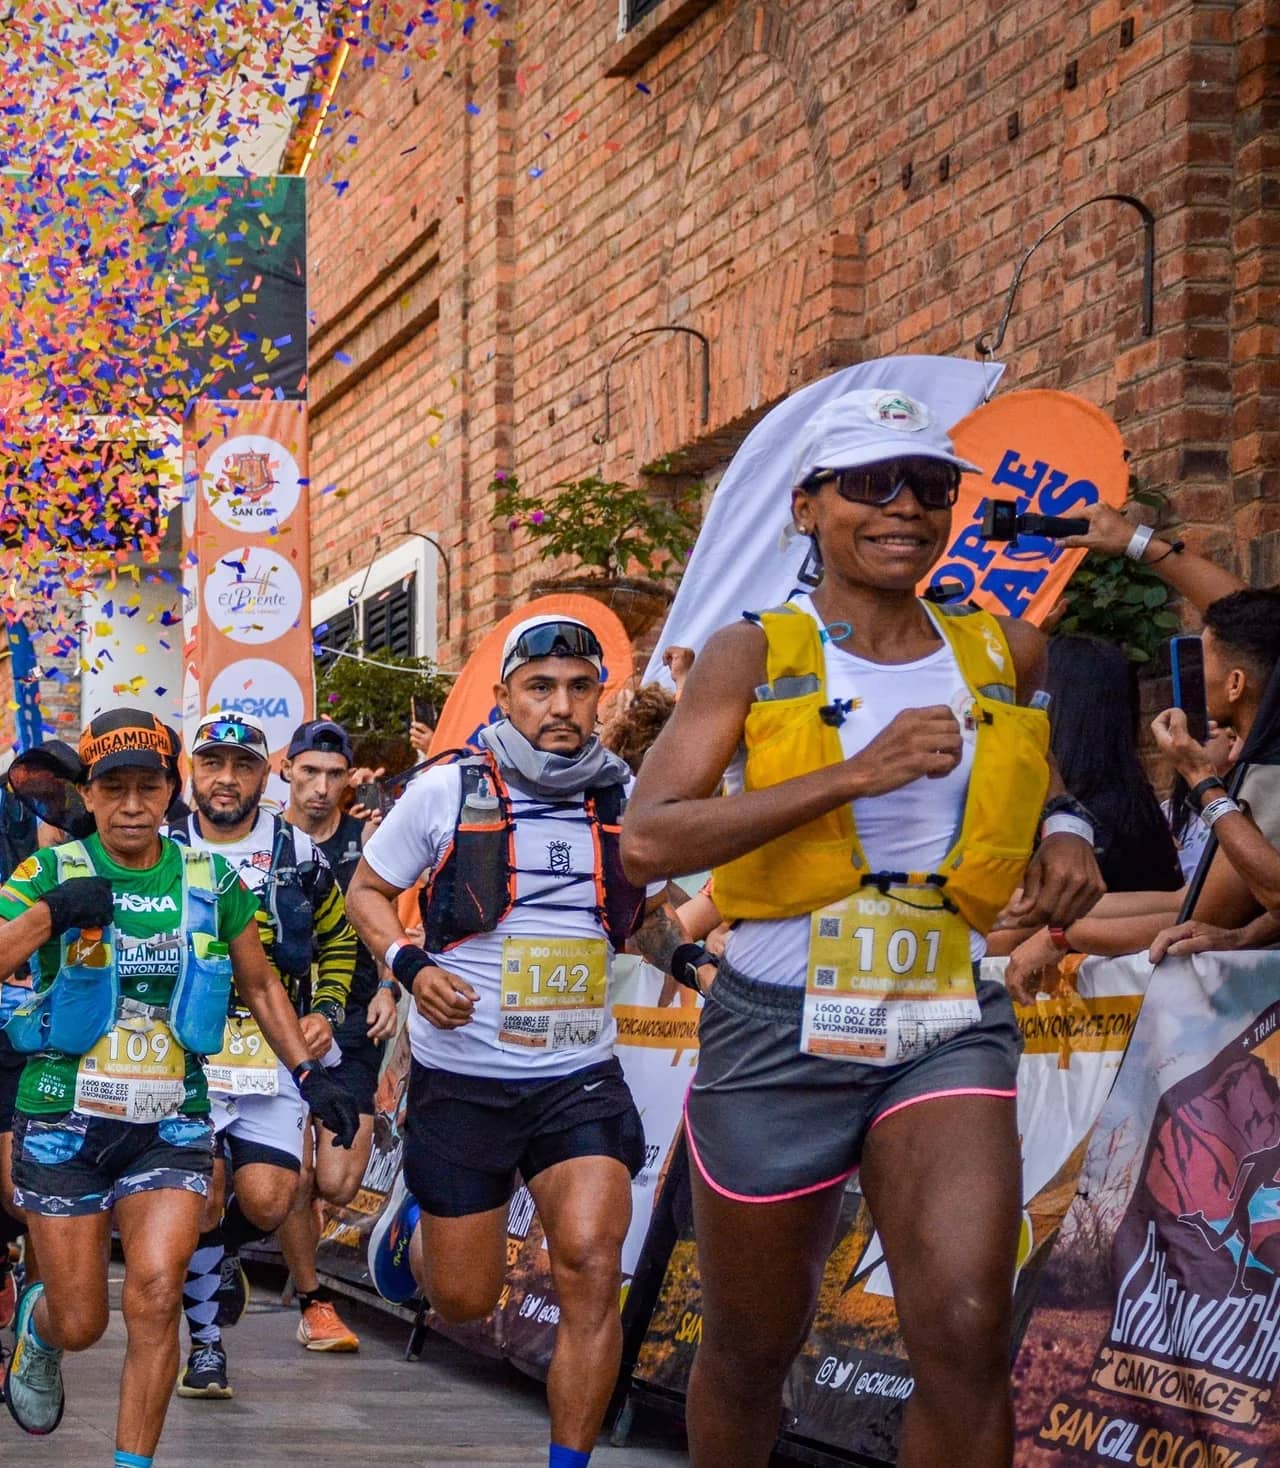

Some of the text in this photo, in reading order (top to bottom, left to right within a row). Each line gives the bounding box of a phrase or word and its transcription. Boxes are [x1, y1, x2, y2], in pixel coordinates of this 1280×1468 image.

[232, 508, 253, 516] SAN
[218, 593, 234, 606] El
[221, 697, 290, 718] HOKA
[83, 731, 170, 762] CHICAMOCHA
[112, 892, 178, 912] HOKA
[852, 926, 942, 975] 101
[117, 964, 180, 975] ANYON RAC
[527, 963, 591, 994] 142
[813, 1014, 841, 1023] 0117
[815, 1003, 842, 1014] 0091
[845, 1006, 865, 1015] 700
[844, 1016, 865, 1025] 700
[1253, 1012, 1278, 1043] TRAIL
[106, 1030, 170, 1062] 109
[228, 1035, 262, 1057] 89
[37, 1082, 65, 1098] 2025
[1111, 1220, 1280, 1382] CHICAMOCH
